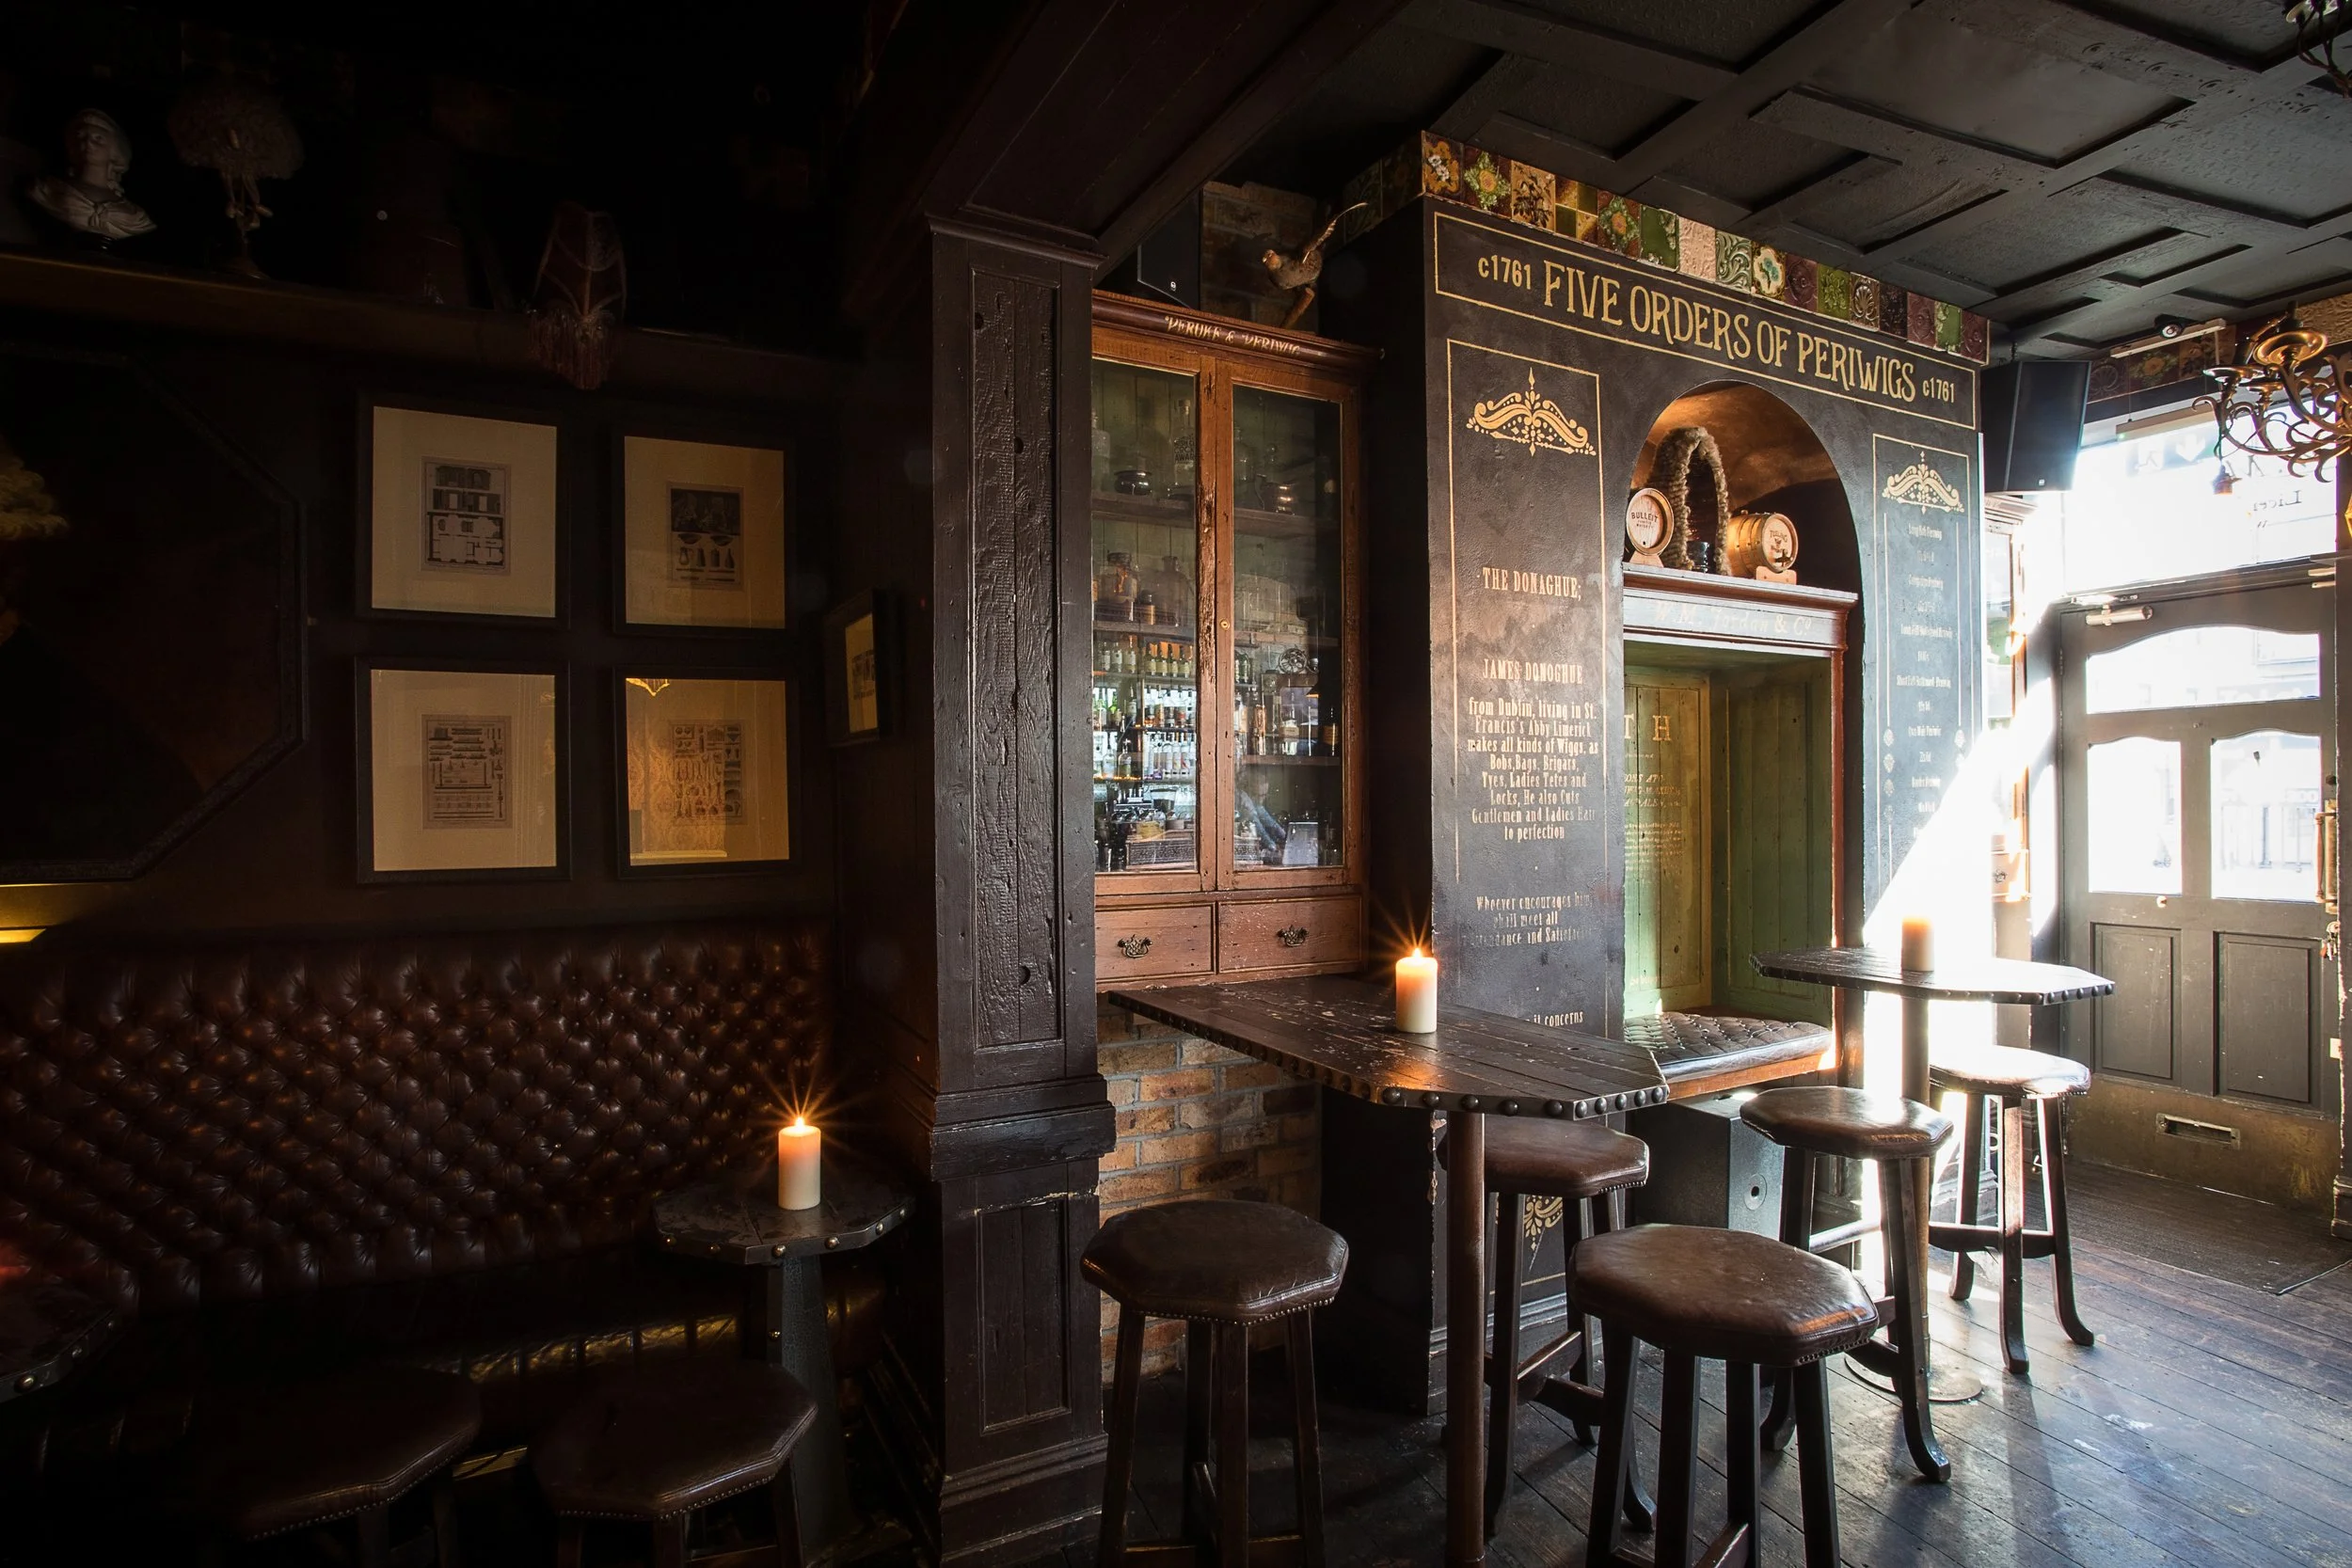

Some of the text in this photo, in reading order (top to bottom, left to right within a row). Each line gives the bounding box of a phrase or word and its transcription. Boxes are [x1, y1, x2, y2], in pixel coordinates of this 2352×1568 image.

[1478, 254, 1957, 404] c1761 FIVE ORDERS OF PERIWIGS c1761
[1630, 511, 1659, 523] BULLEIT
[1482, 566, 1509, 592] THE
[1483, 658, 1583, 685] JAMES DONOGHUE
[1469, 696, 1494, 716] from
[1538, 699, 1568, 721] living
[1571, 701, 1581, 720] in
[1584, 702, 1597, 720] St.
[1528, 719, 1550, 737] Abby
[1553, 720, 1592, 737] Limerick
[1467, 736, 1498, 752] makes
[1501, 736, 1514, 752] all
[1517, 736, 1542, 753] kinds
[1545, 736, 1555, 753] of
[1589, 741, 1598, 754] as
[1510, 771, 1540, 788] Ladies
[1543, 771, 1567, 788] Tetes
[1570, 772, 1587, 787] and
[1523, 789, 1535, 805] He
[1538, 788, 1557, 805] also
[1560, 788, 1580, 805] Cuts
[1471, 807, 1522, 824] Gentlemen
[1526, 806, 1542, 822] and
[1546, 806, 1575, 822] Ladies
[1504, 823, 1565, 843] to perfection
[1476, 895, 1516, 911] Whoever
[1519, 895, 1571, 911] encourages
[1520, 912, 1543, 927] meet
[1546, 911, 1558, 927] all
[1527, 928, 1542, 944] and
[1544, 1011, 1584, 1027] concerns
